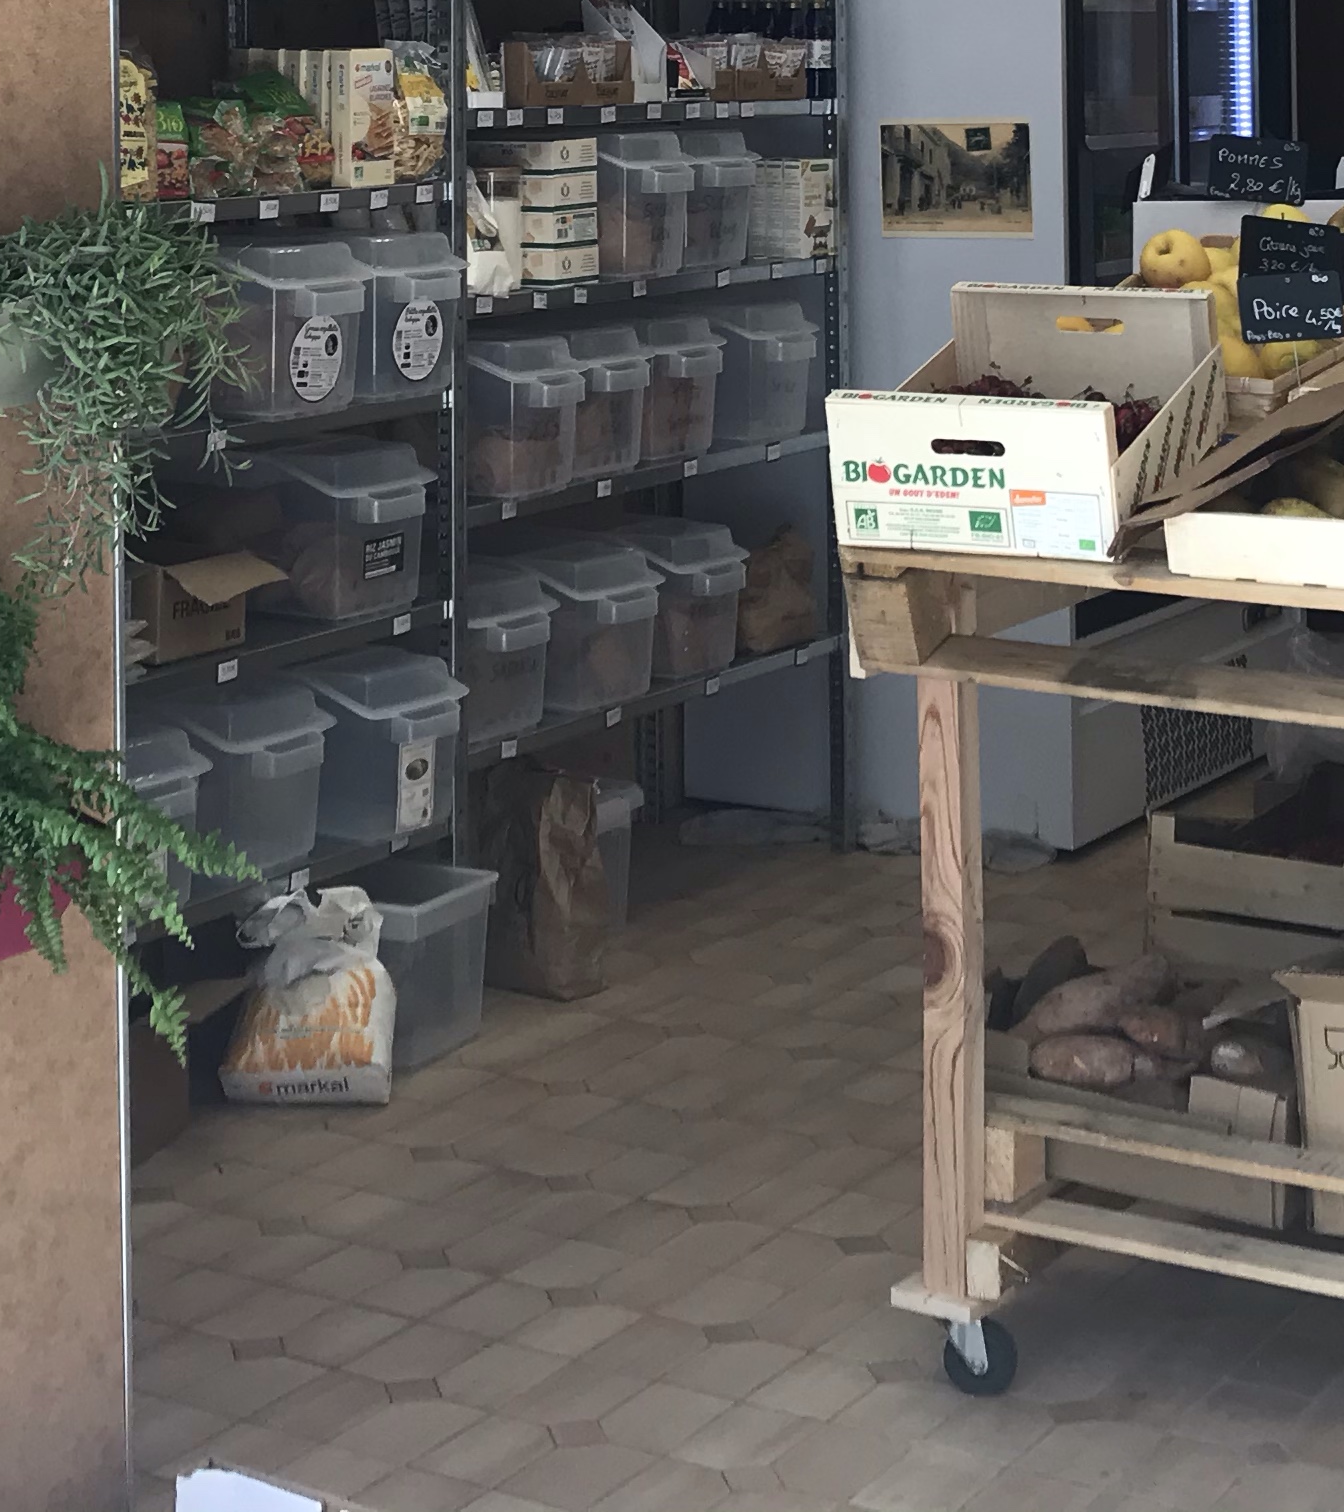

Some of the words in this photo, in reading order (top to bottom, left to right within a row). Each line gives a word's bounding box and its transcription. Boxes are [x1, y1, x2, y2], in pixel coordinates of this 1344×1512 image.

[360, 62, 381, 73] markal
[1217, 147, 1284, 170] POMMES
[1228, 173, 1264, 194] 2,80
[1251, 297, 1301, 322] Poire
[377, 535, 403, 551] JASMIN
[275, 1075, 350, 1097] markal
